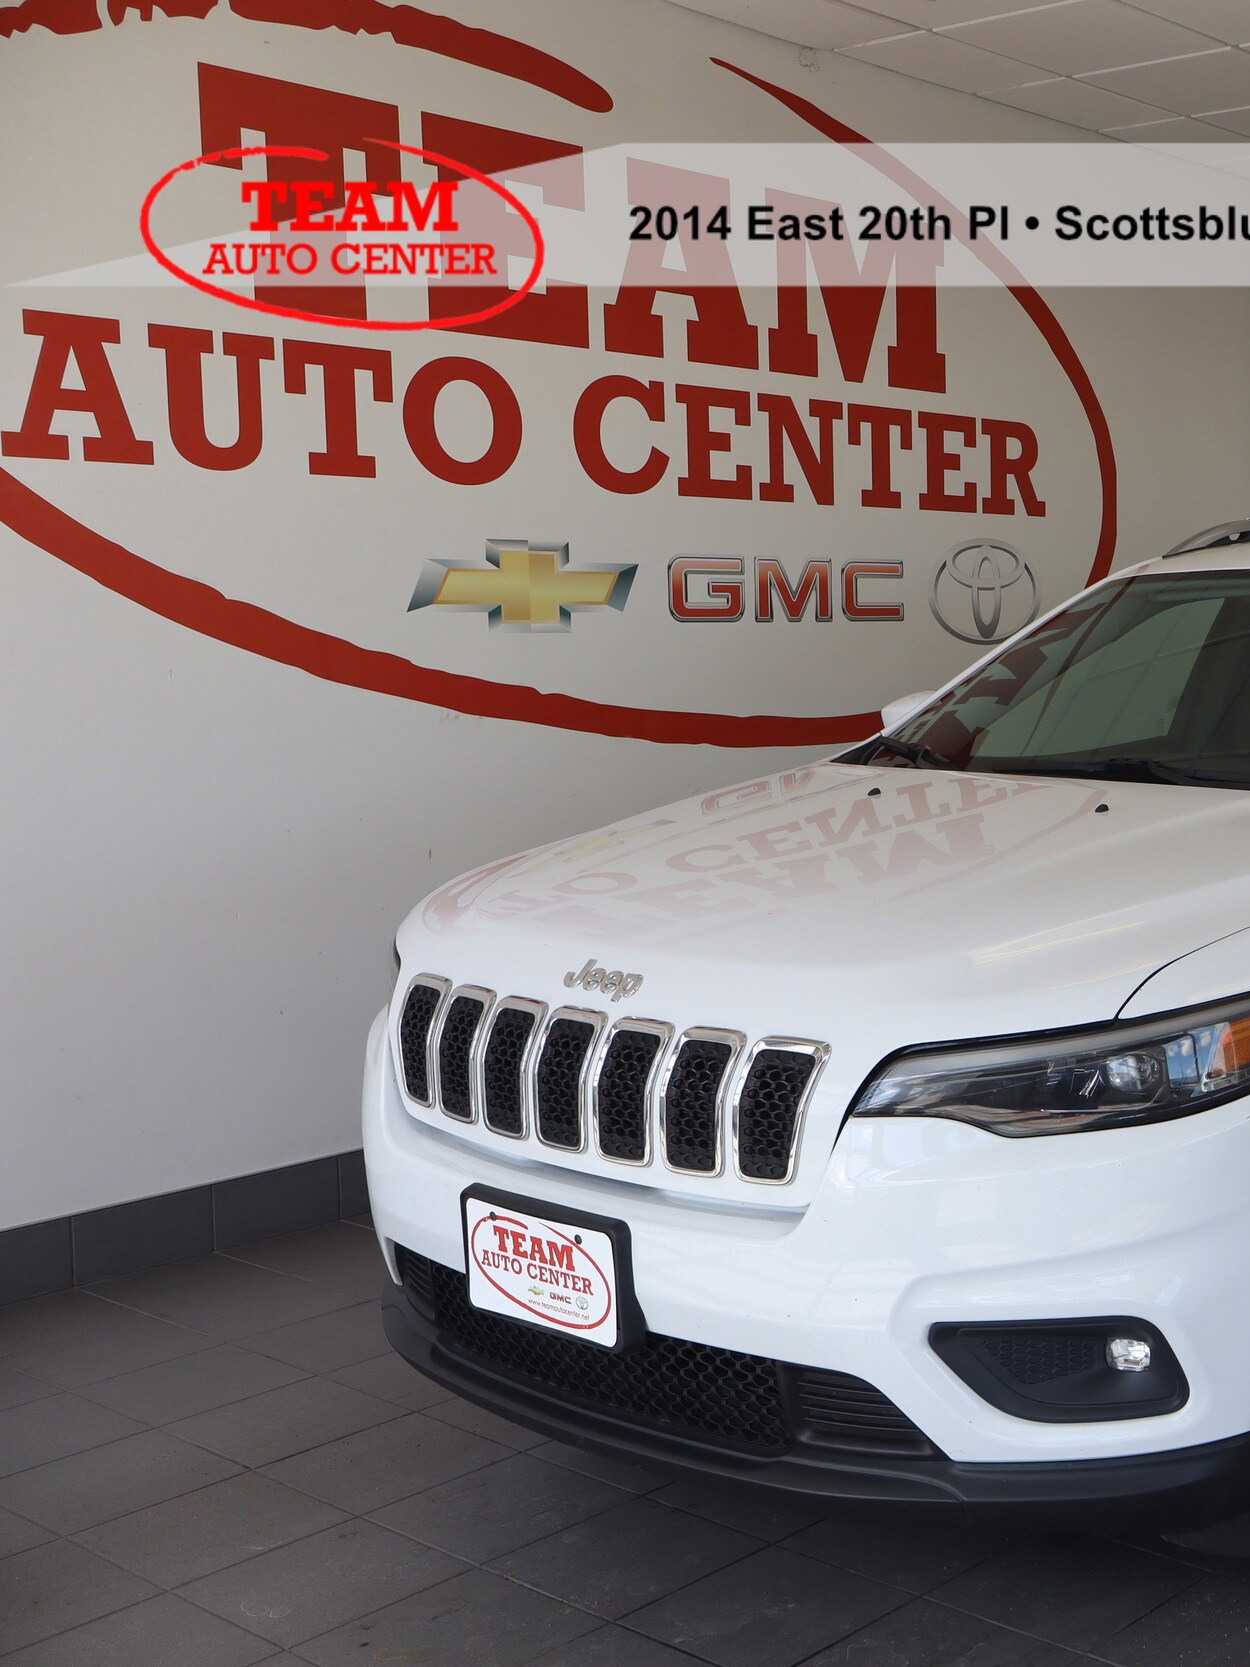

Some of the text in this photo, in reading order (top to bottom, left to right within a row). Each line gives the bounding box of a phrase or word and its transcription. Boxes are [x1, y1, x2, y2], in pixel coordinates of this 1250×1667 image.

[197, 62, 947, 394] TEAM
[1, 308, 1047, 518] AUTO CENTER
[667, 553, 904, 623] GMC
[563, 958, 644, 1003] Jeep
[493, 1225, 576, 1272] TEAM
[481, 1249, 594, 1296] AUTO CENTER
[527, 1298, 590, 1321] www.teamautocenter.net
[549, 1291, 572, 1305] GMC
